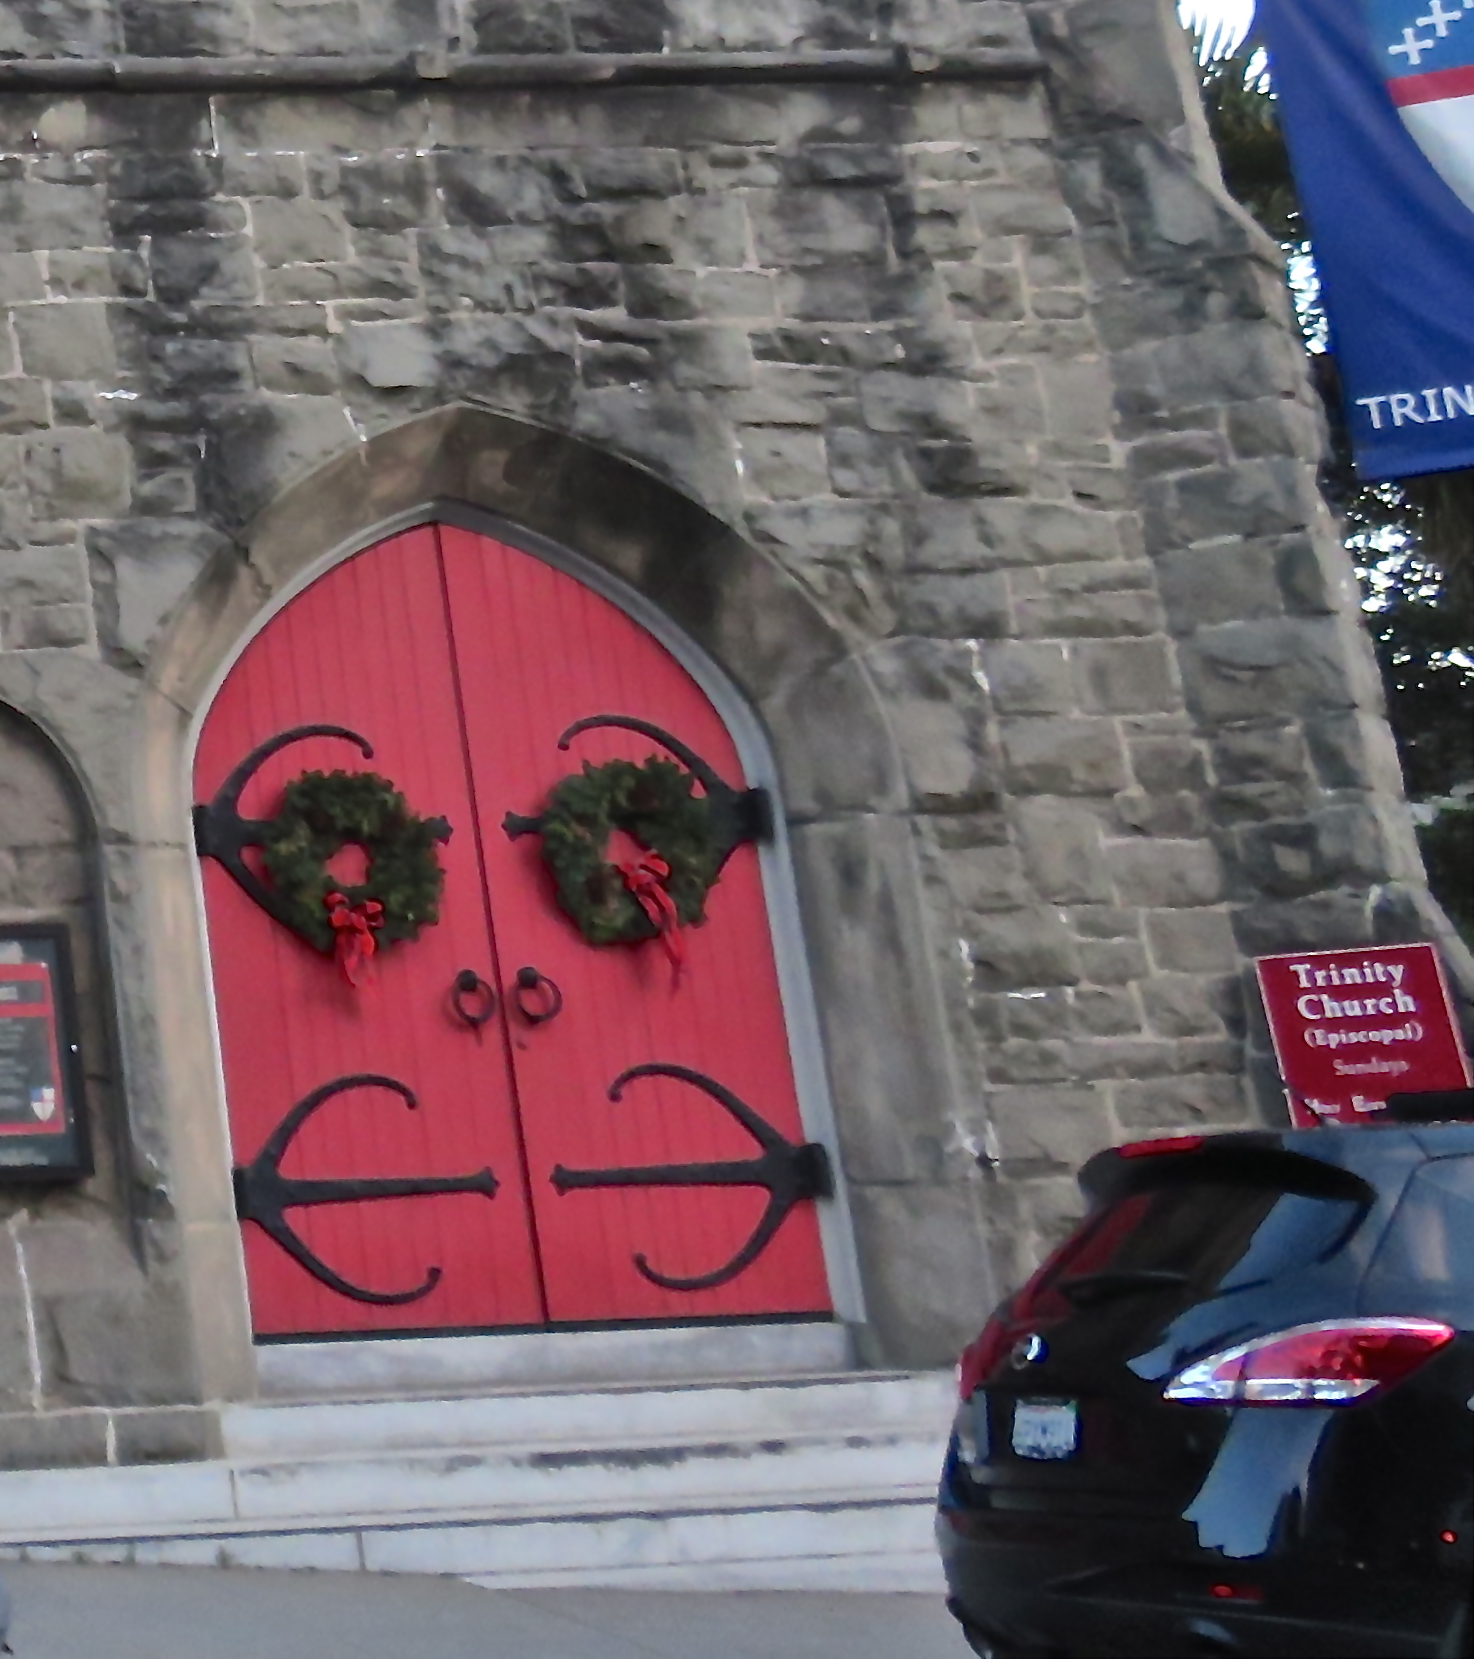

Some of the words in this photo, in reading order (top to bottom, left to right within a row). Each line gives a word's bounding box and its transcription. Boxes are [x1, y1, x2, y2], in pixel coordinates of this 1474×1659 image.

[1355, 384, 1474, 429] TRIN
[1289, 961, 1404, 989] Trinity
[1297, 989, 1416, 1020] Church
[1304, 1021, 1423, 1048] (Episcopal)
